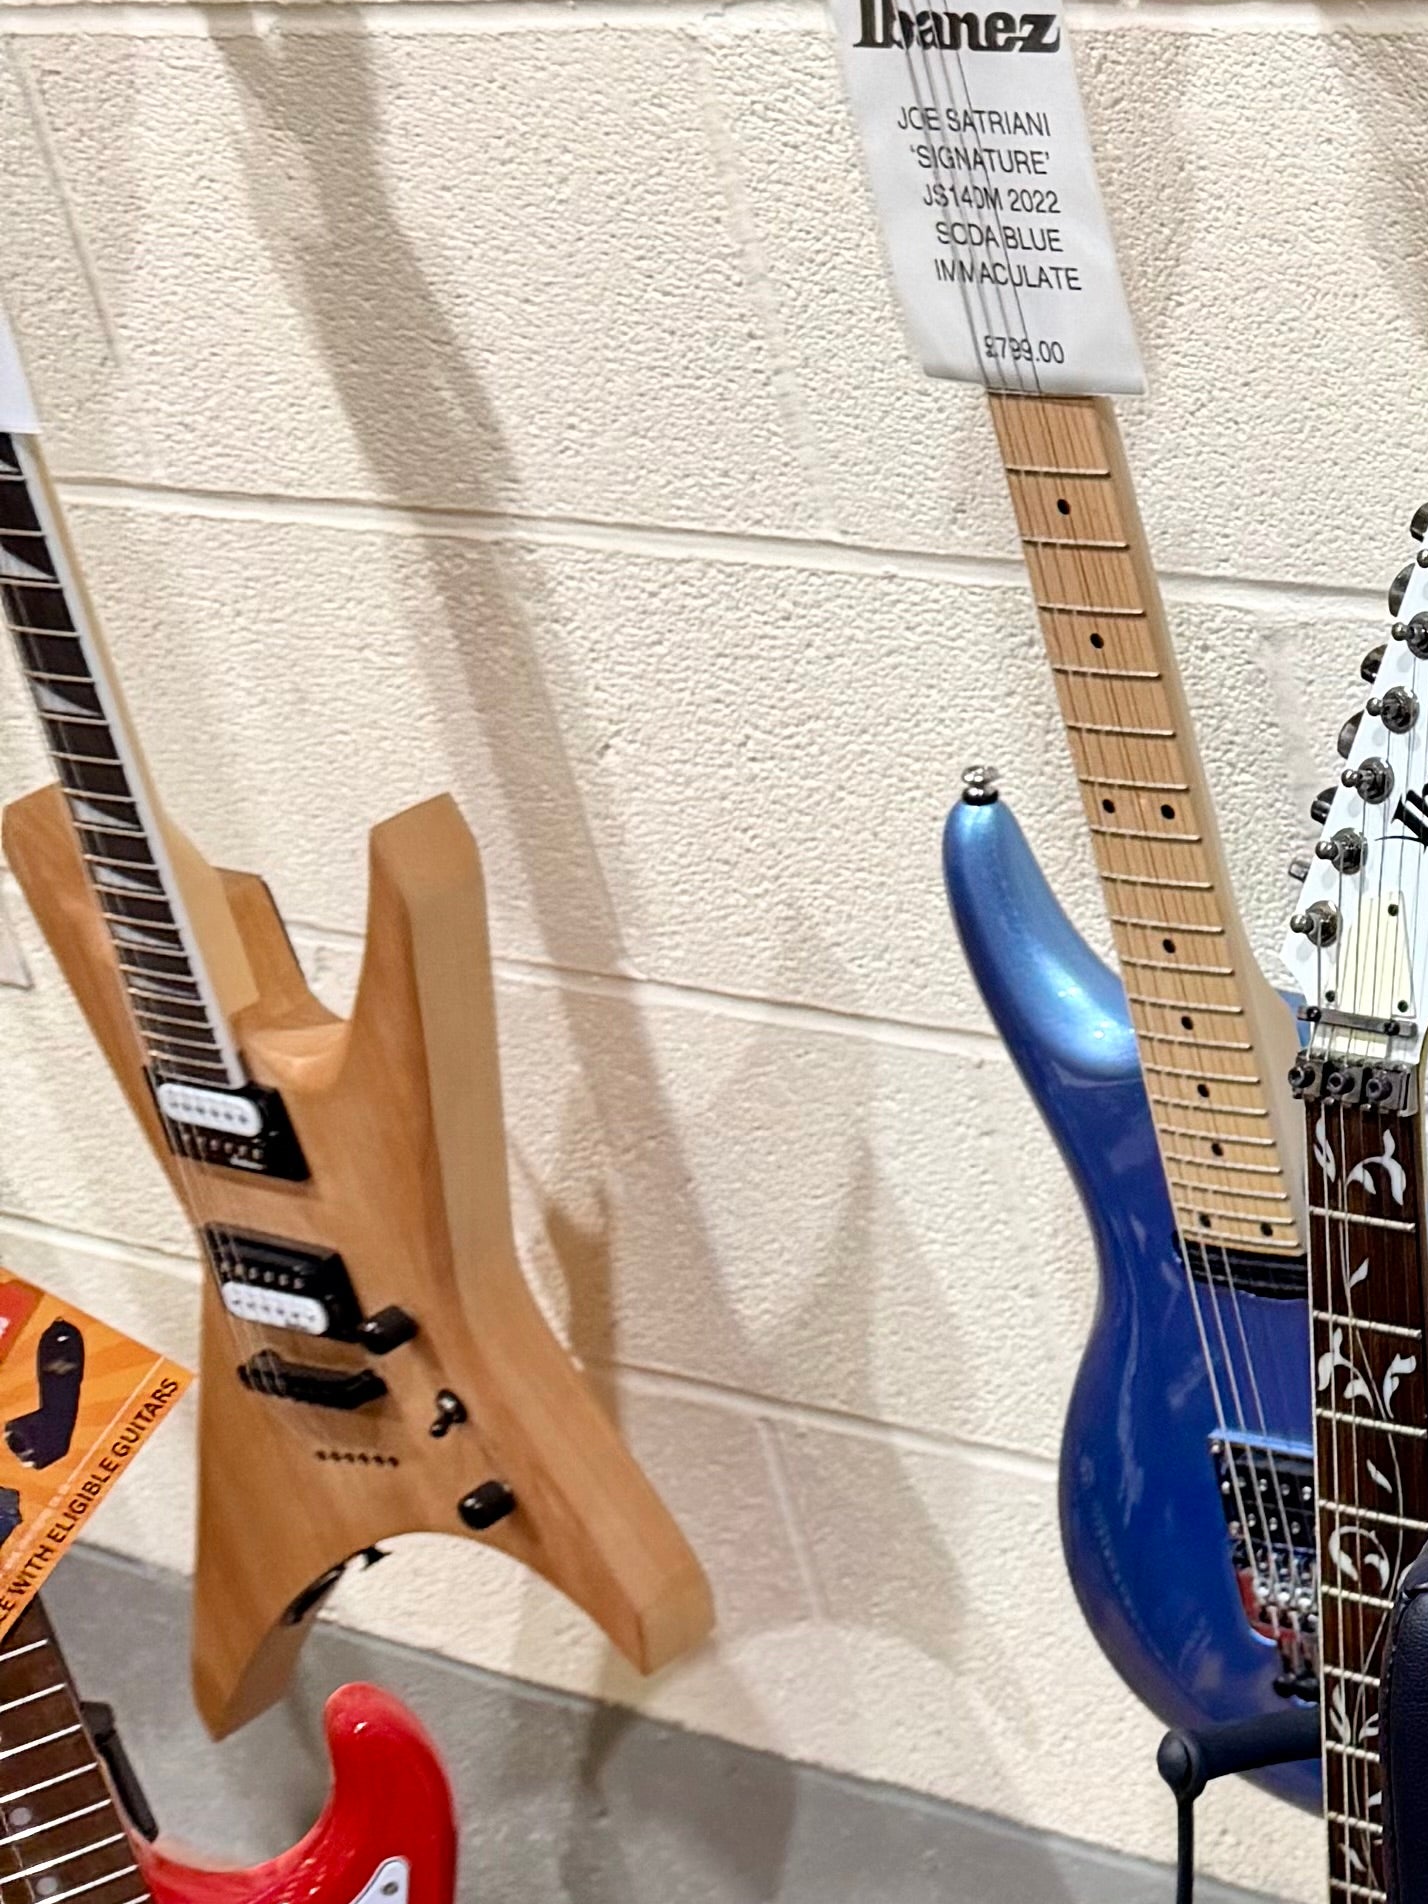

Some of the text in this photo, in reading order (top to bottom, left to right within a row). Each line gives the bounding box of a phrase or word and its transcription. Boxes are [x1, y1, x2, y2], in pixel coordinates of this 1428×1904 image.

[898, 106, 1051, 137] JOE SATRIANI
[1007, 188, 1061, 214] 2022
[935, 221, 1064, 253] SODA BLUE
[934, 258, 1082, 291] IMMACULATE
[7, 1544, 55, 1595] WITH
[47, 1457, 121, 1544] ELIGIBLE
[111, 1377, 179, 1458] GUITARS
